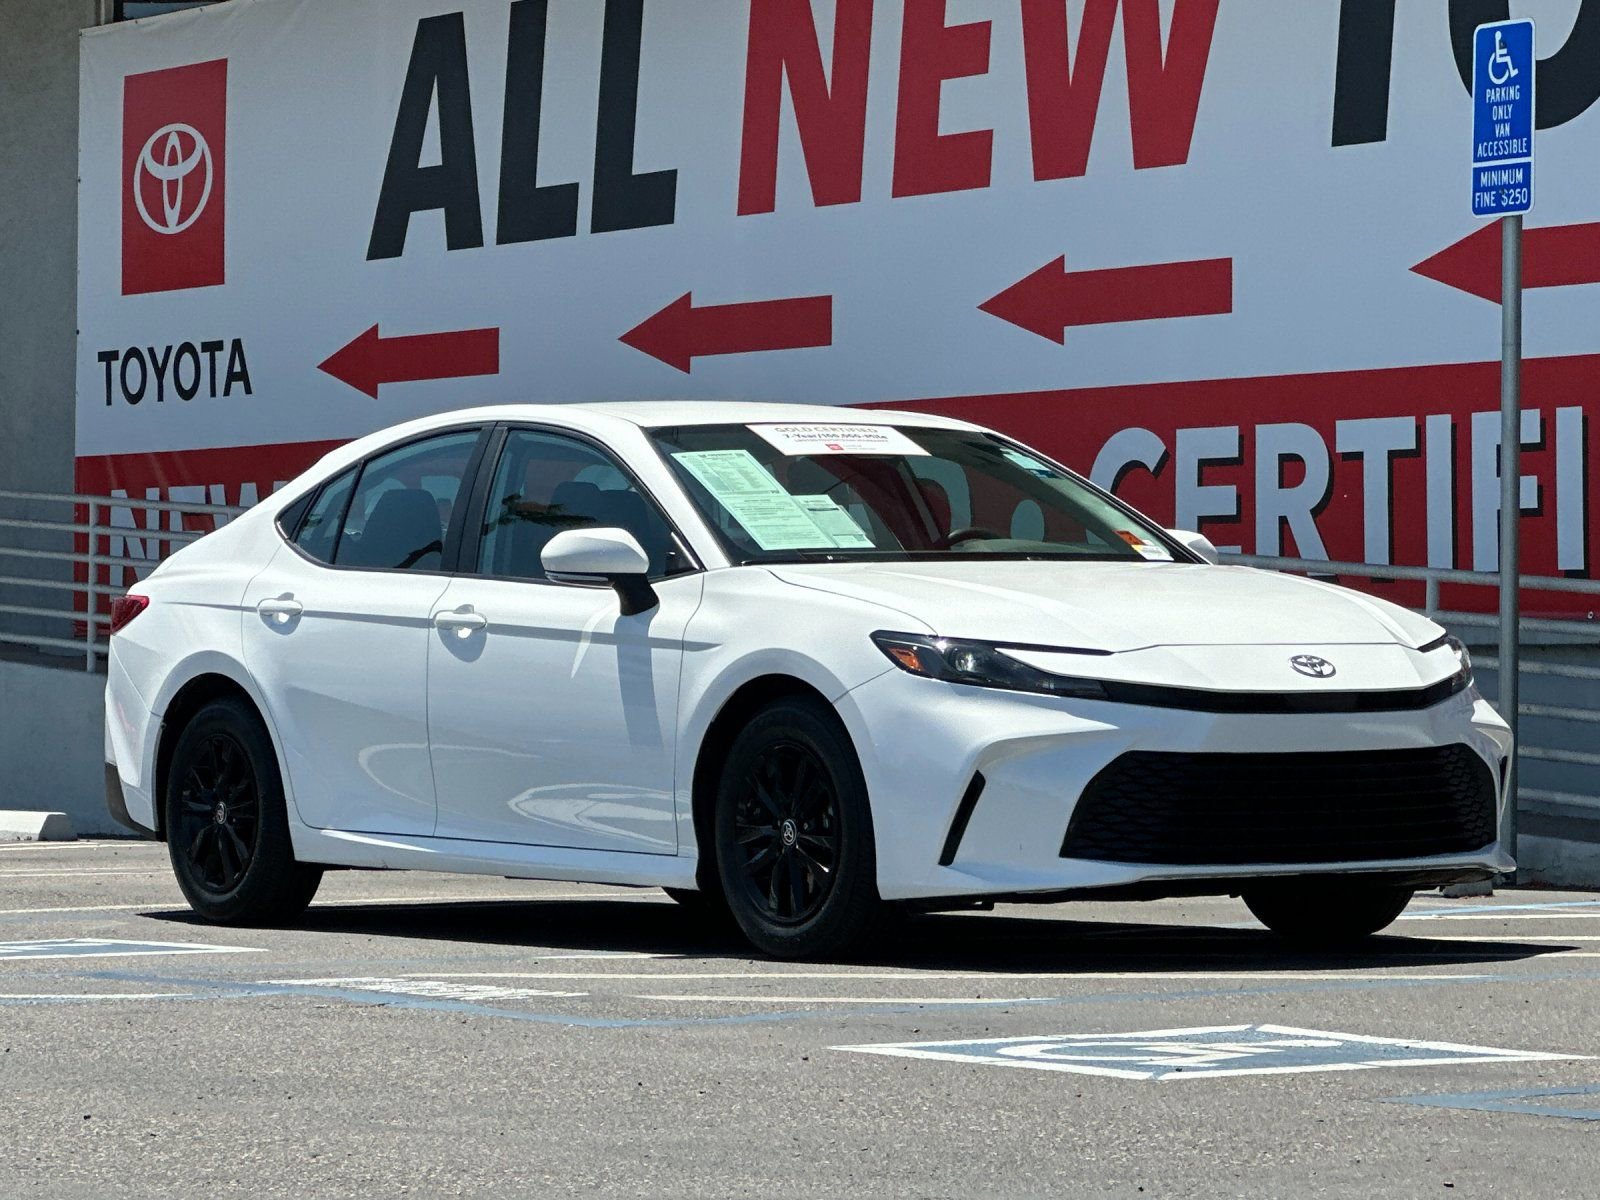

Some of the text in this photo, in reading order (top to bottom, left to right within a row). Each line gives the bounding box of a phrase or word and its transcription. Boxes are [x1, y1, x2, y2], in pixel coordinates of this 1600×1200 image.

[1486, 86, 1520, 103] PARKING
[1492, 104, 1513, 121] ONLY
[366, 0, 678, 260] ALL
[737, 0, 1219, 216] NEW
[1495, 123, 1510, 138] VAN
[1477, 138, 1528, 158] ACCESSIBLE
[1480, 168, 1523, 187] MINIMUM
[1474, 188, 1528, 209] FINE $250
[97, 338, 253, 406] TOYOTA
[110, 481, 290, 602] NE
